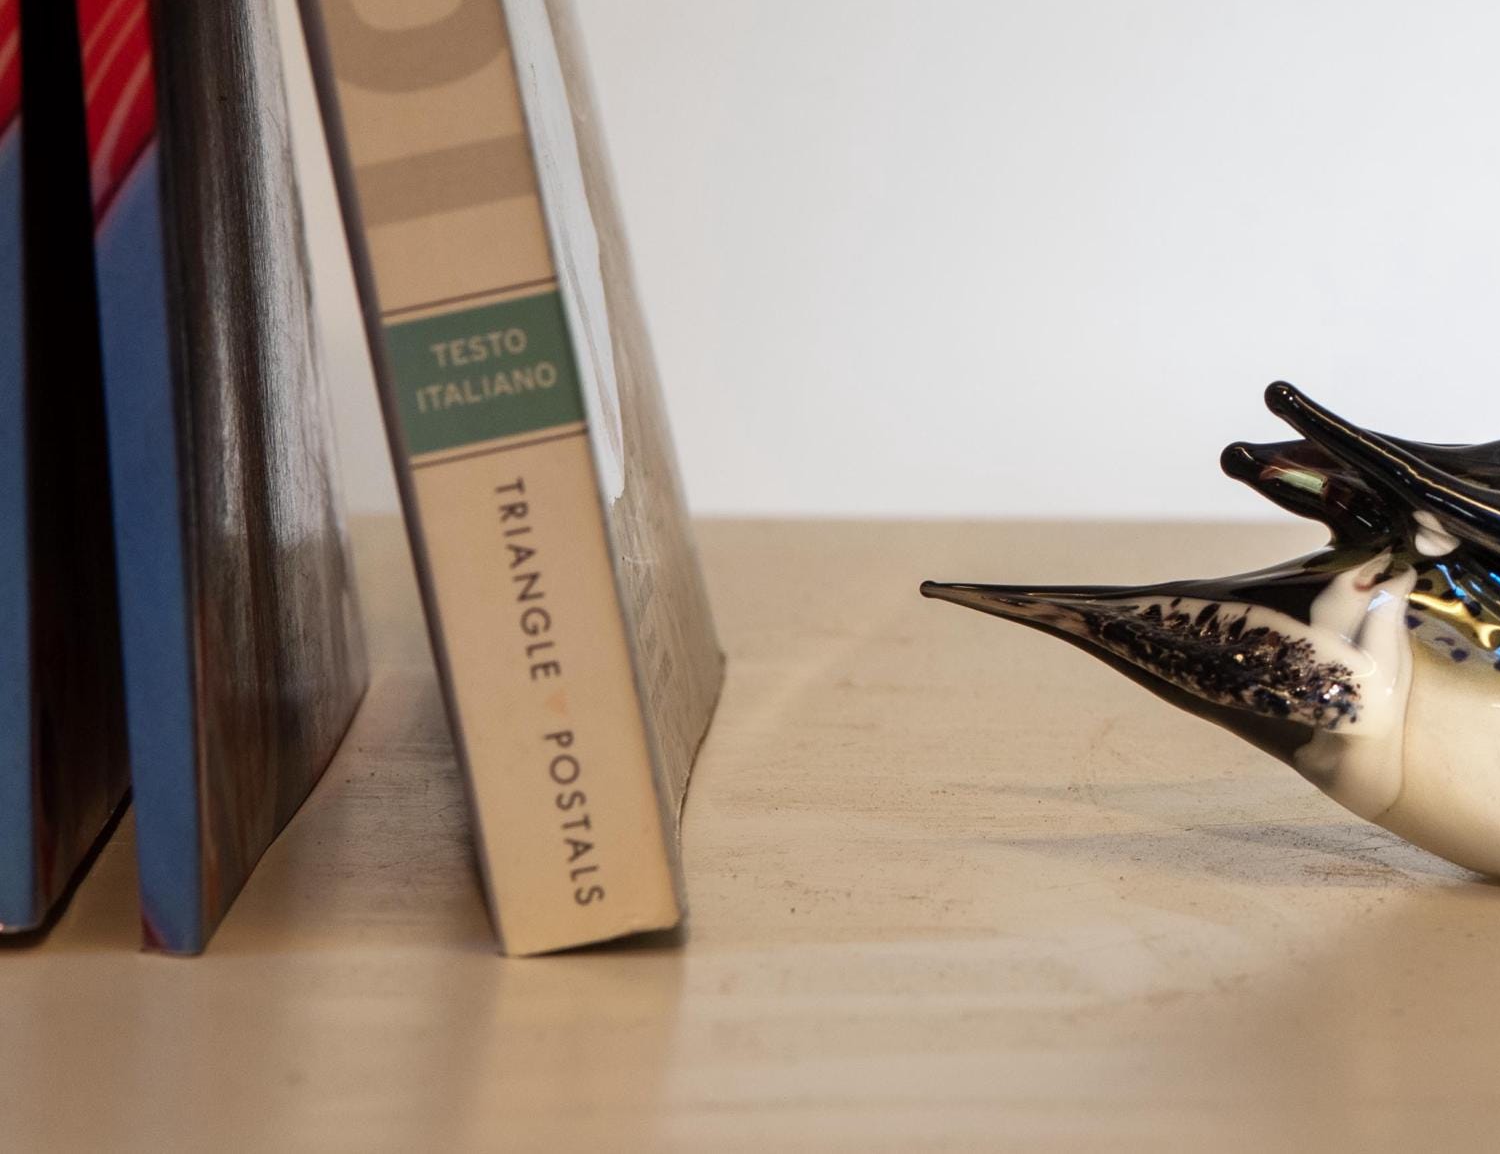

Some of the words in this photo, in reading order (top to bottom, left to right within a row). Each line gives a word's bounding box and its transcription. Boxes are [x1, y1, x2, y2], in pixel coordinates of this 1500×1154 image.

[431, 328, 528, 367] TESTO
[416, 362, 558, 412] ITALIANO
[494, 476, 561, 682] TRIANGLE
[542, 729, 605, 908] POSTALS
